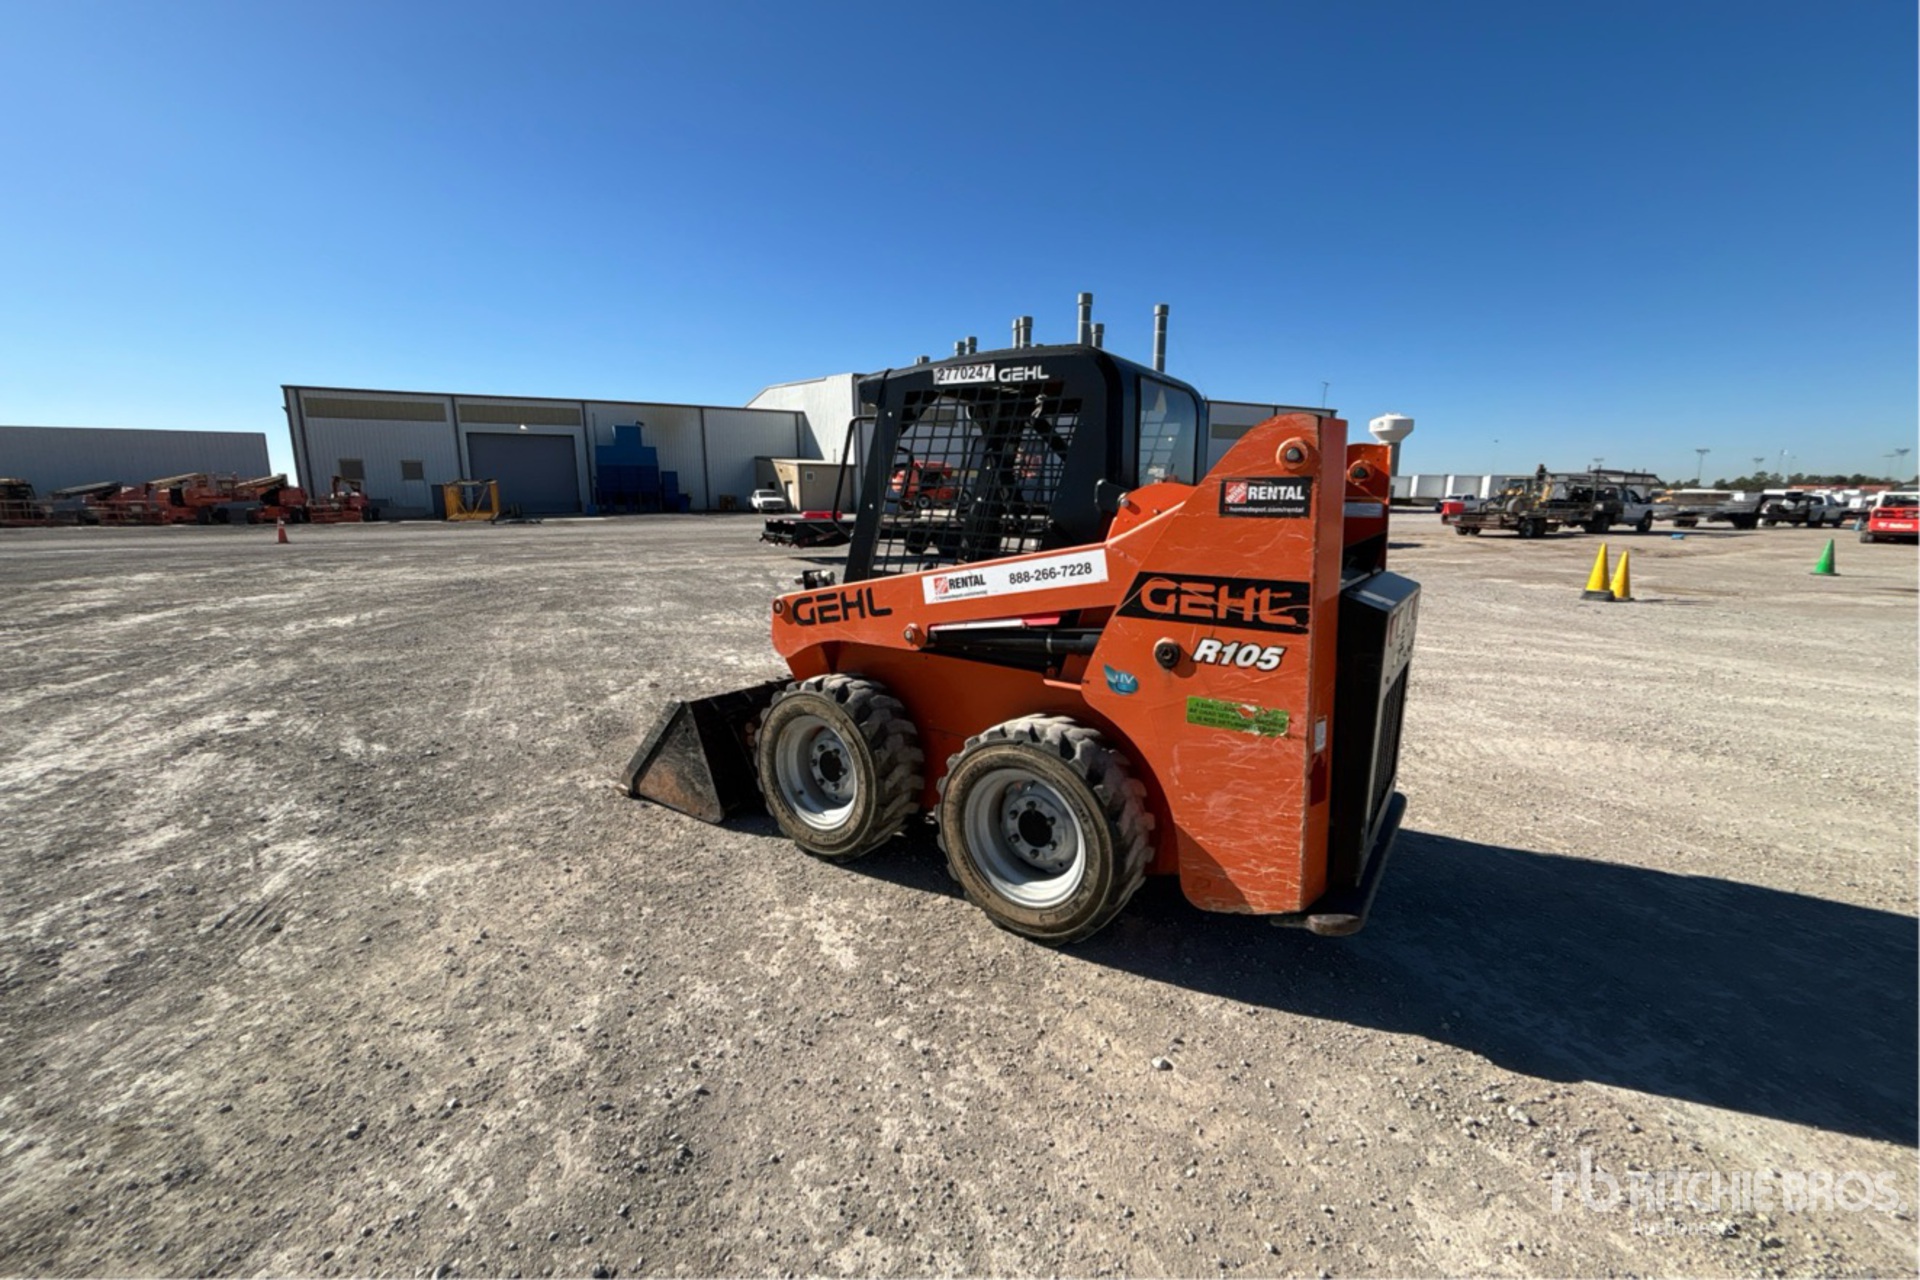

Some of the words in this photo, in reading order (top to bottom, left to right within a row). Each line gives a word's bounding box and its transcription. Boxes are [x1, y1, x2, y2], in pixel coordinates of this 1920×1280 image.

[937, 365, 991, 381] 2770247
[998, 365, 1050, 383] GEHL
[1247, 485, 1305, 500] RENTAL
[948, 574, 987, 591] RENTAL
[1008, 561, 1093, 585] 888-266-7228
[792, 586, 893, 626] GEHL
[1141, 579, 1297, 625] GEHL
[1192, 637, 1286, 672] R105
